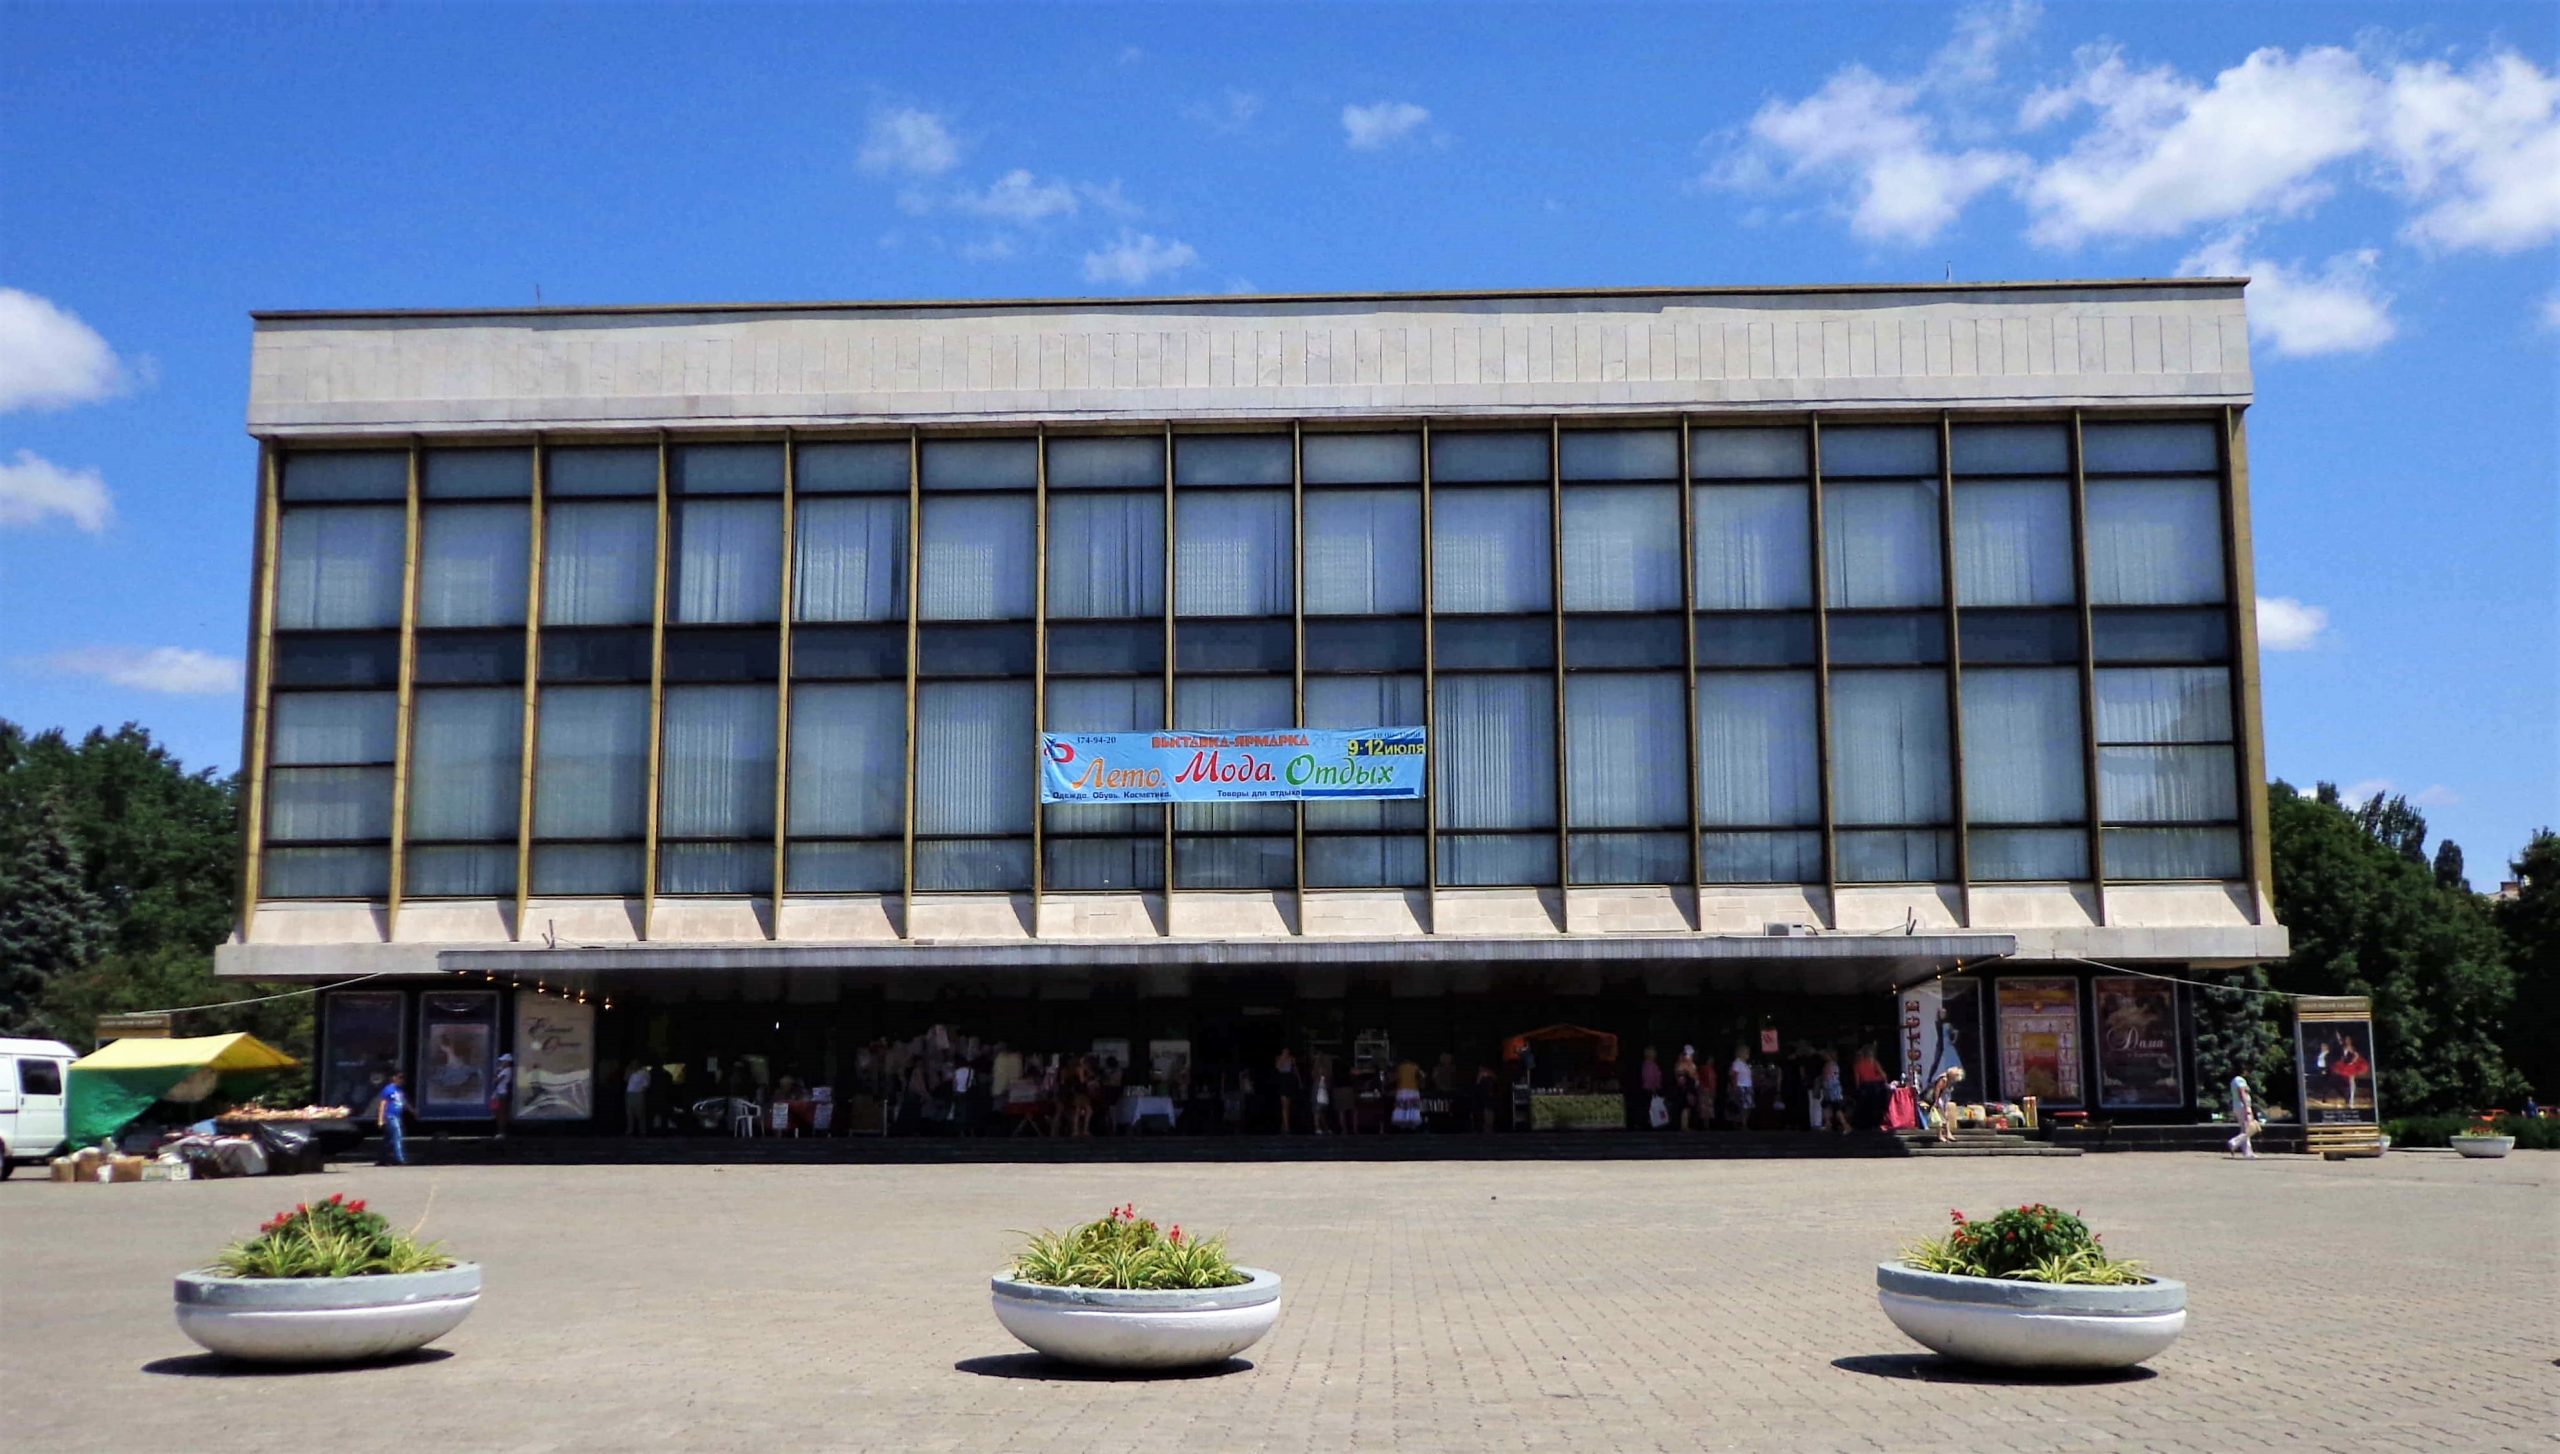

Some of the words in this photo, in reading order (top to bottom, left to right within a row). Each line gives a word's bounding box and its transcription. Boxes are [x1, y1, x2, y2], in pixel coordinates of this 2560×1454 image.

[1071, 757, 1168, 789] Лето.
[1174, 750, 1276, 783] Мода.
[1286, 753, 1394, 786] Отдых
